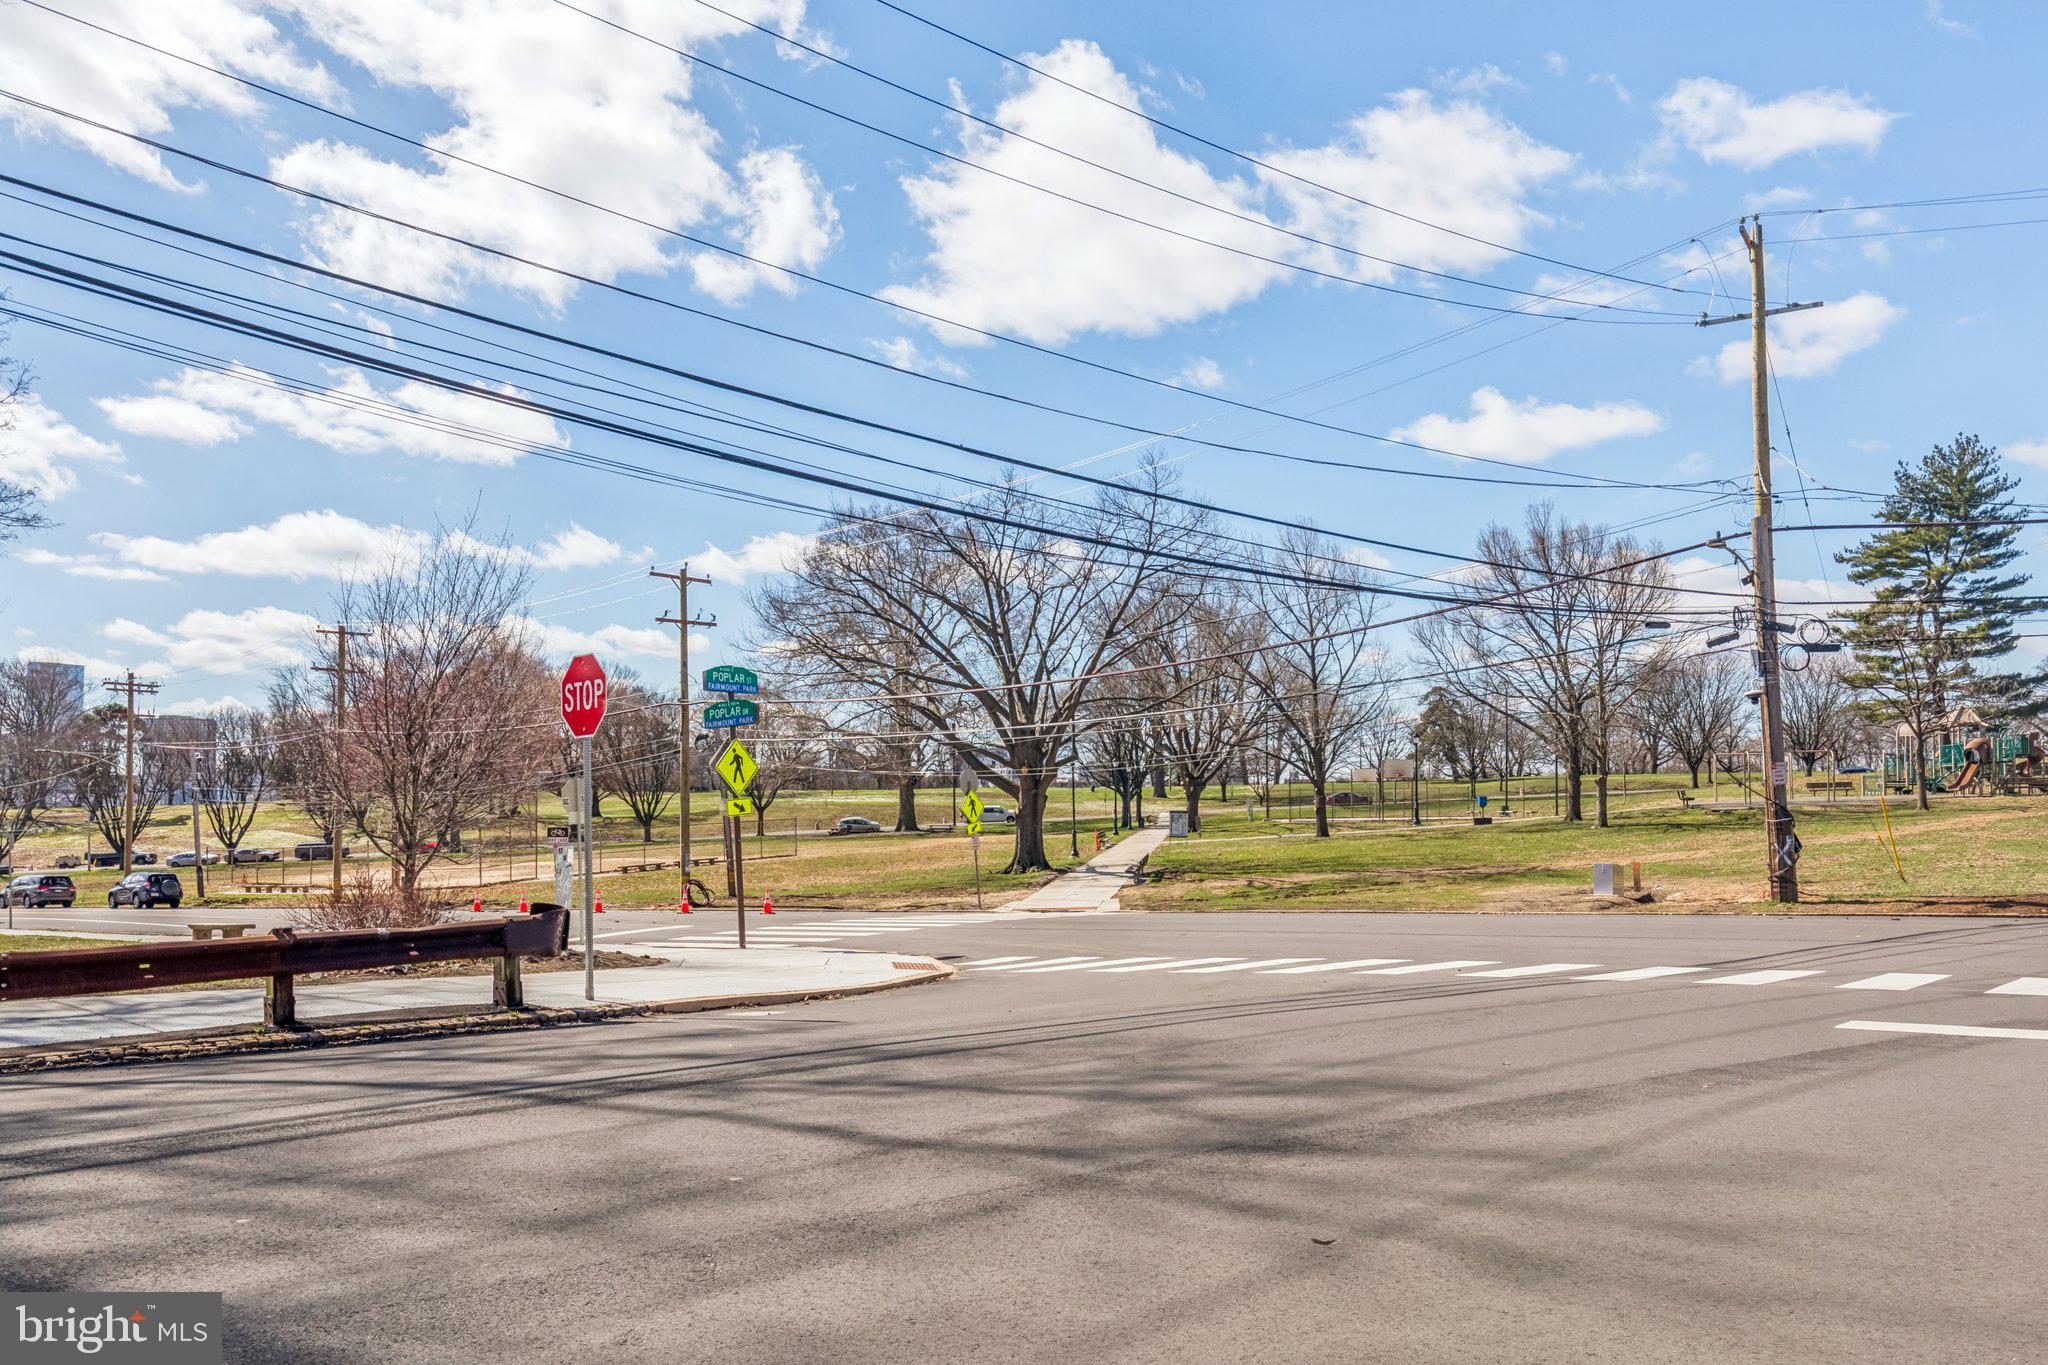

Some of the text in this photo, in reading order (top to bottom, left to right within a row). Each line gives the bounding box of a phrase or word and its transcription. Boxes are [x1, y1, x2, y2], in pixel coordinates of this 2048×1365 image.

[712, 671, 745, 684] POPLAR
[708, 682, 740, 691] FAIRMOUNT
[564, 679, 604, 713] STOP
[709, 706, 741, 719] POPLAR
[705, 716, 754, 728] FAIRMOUNT PARK
